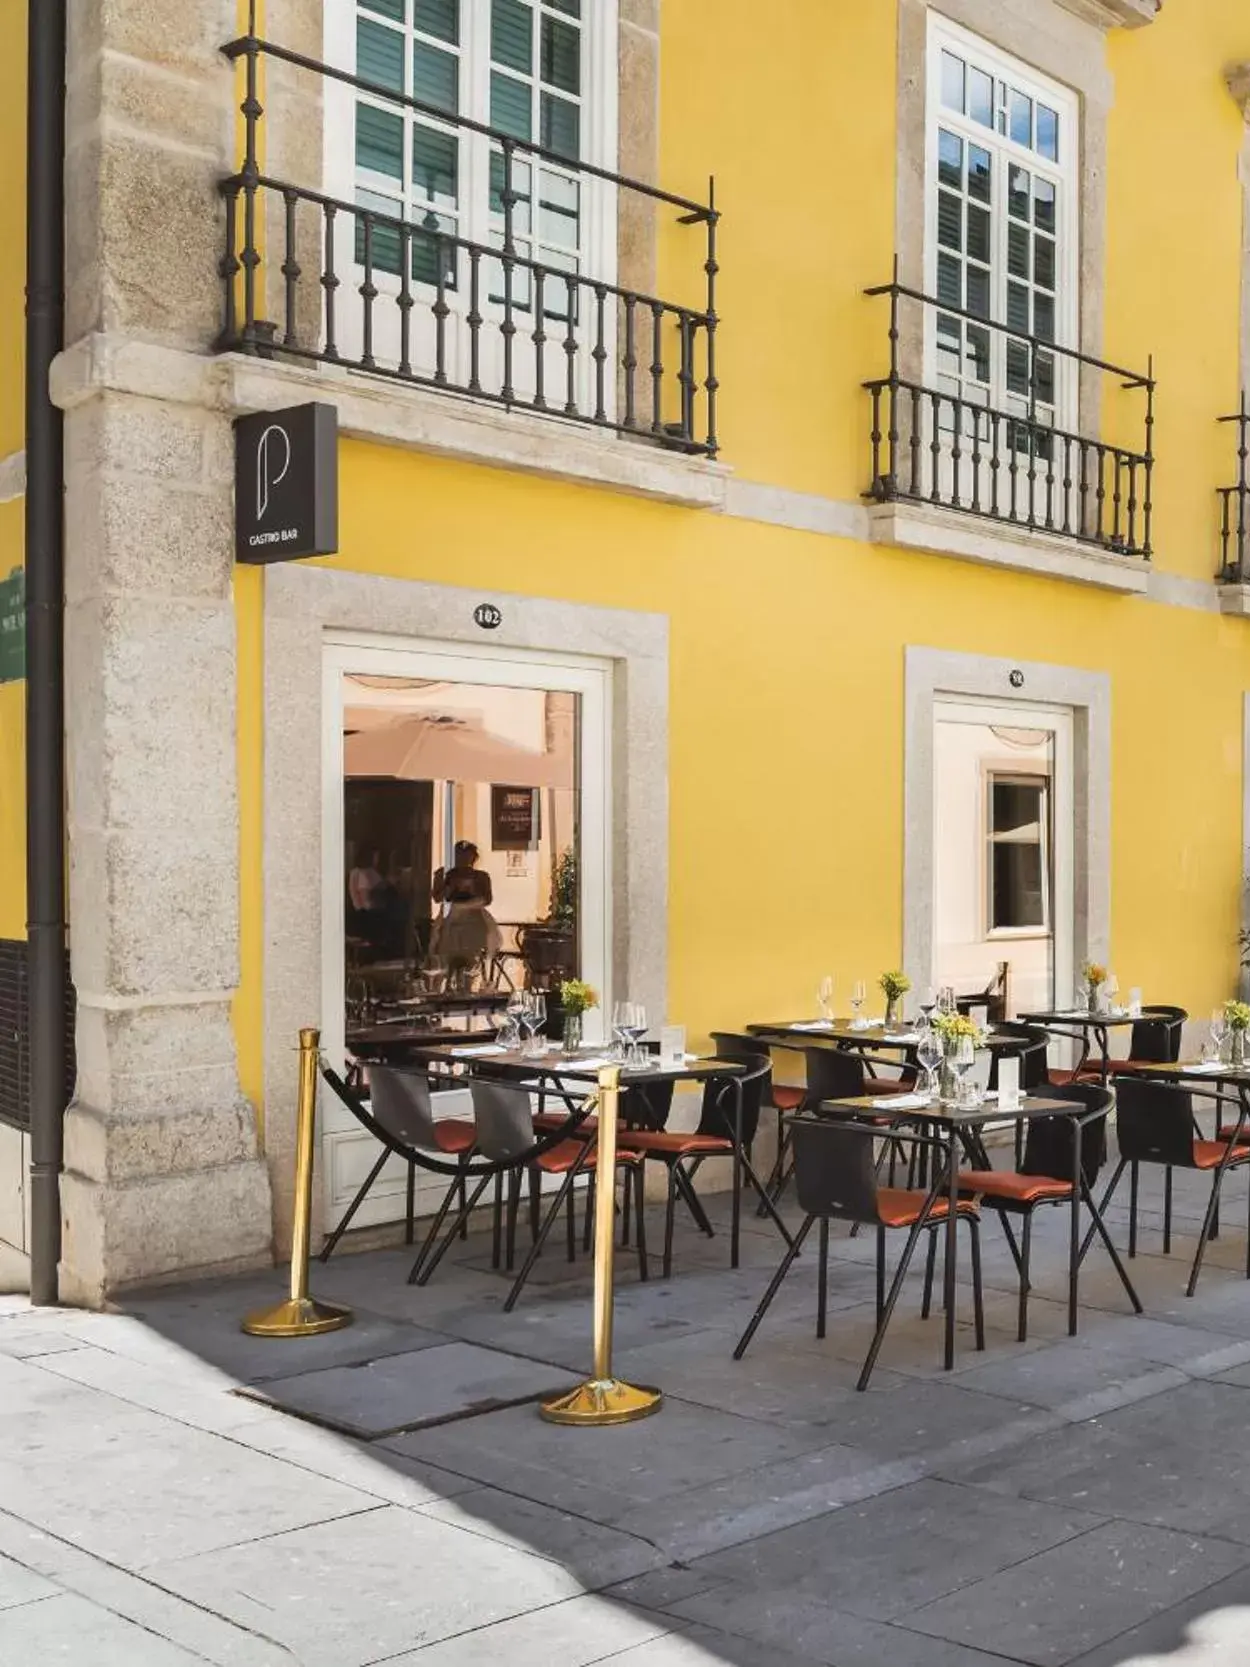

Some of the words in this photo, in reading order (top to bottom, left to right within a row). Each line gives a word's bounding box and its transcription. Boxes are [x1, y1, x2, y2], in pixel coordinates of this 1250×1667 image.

[249, 531, 280, 546] GASTRO
[281, 528, 298, 541] BAR
[478, 609, 499, 624] 102
